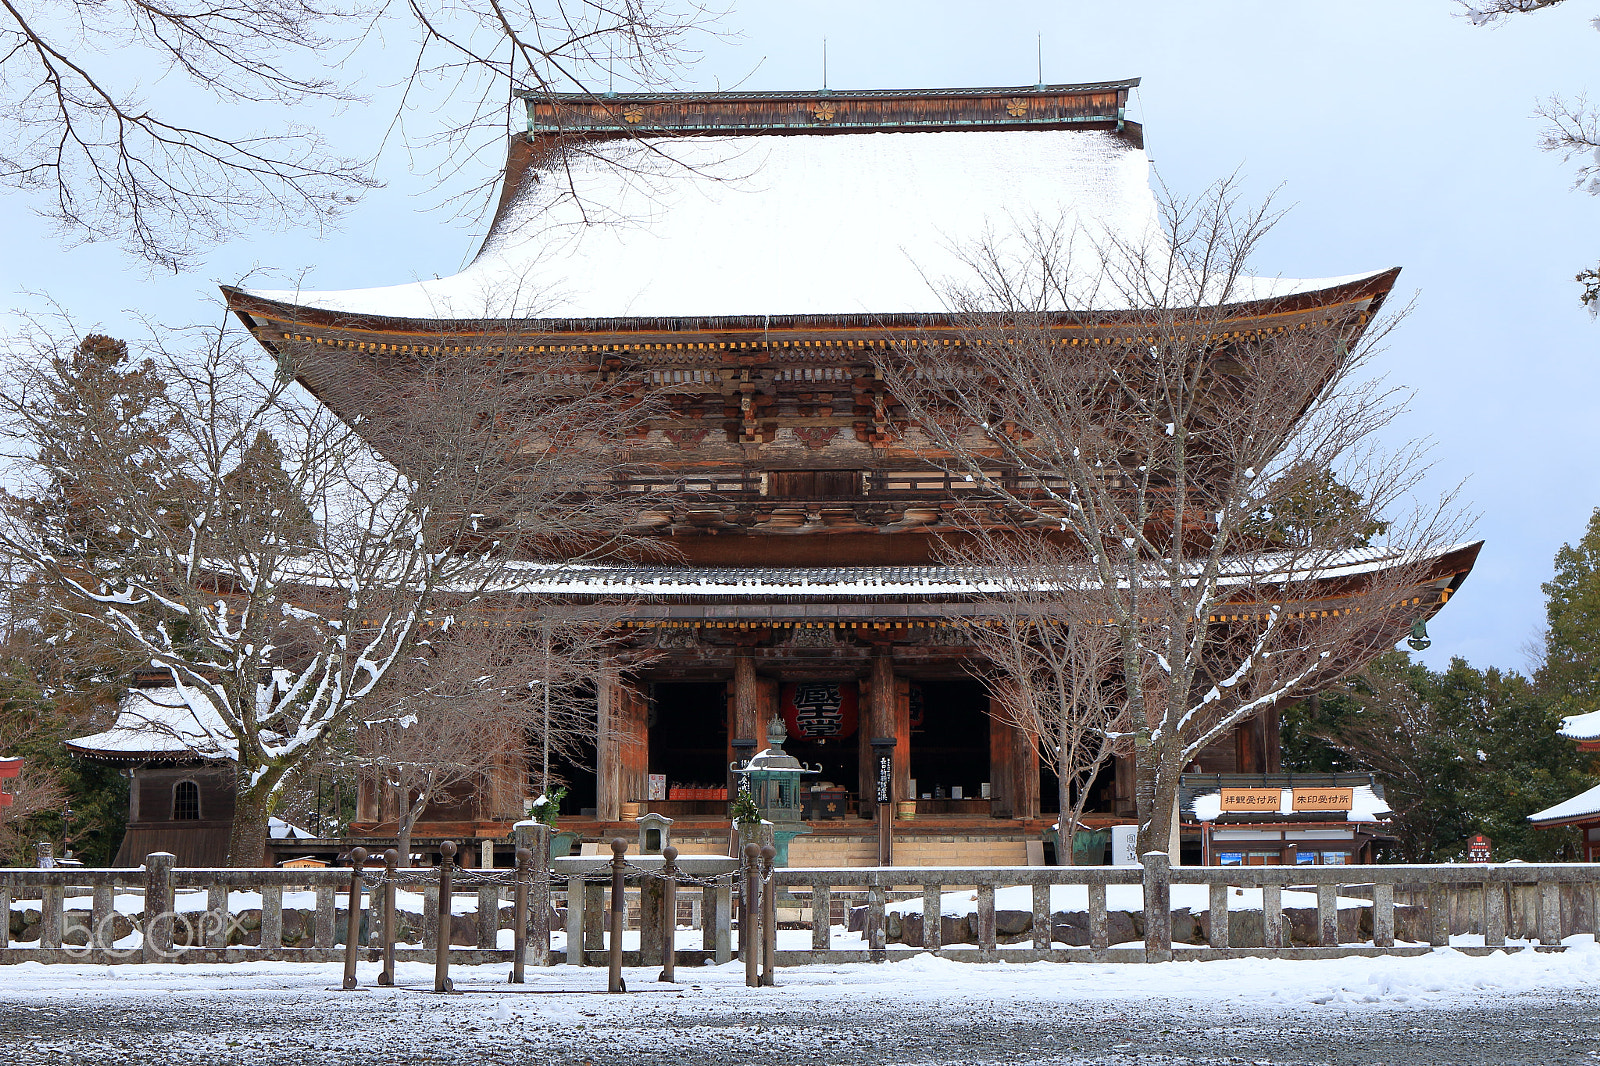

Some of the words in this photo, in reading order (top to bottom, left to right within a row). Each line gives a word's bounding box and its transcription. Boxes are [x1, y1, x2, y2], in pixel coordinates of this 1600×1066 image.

[1297, 795, 1349, 804] 朱印受付所
